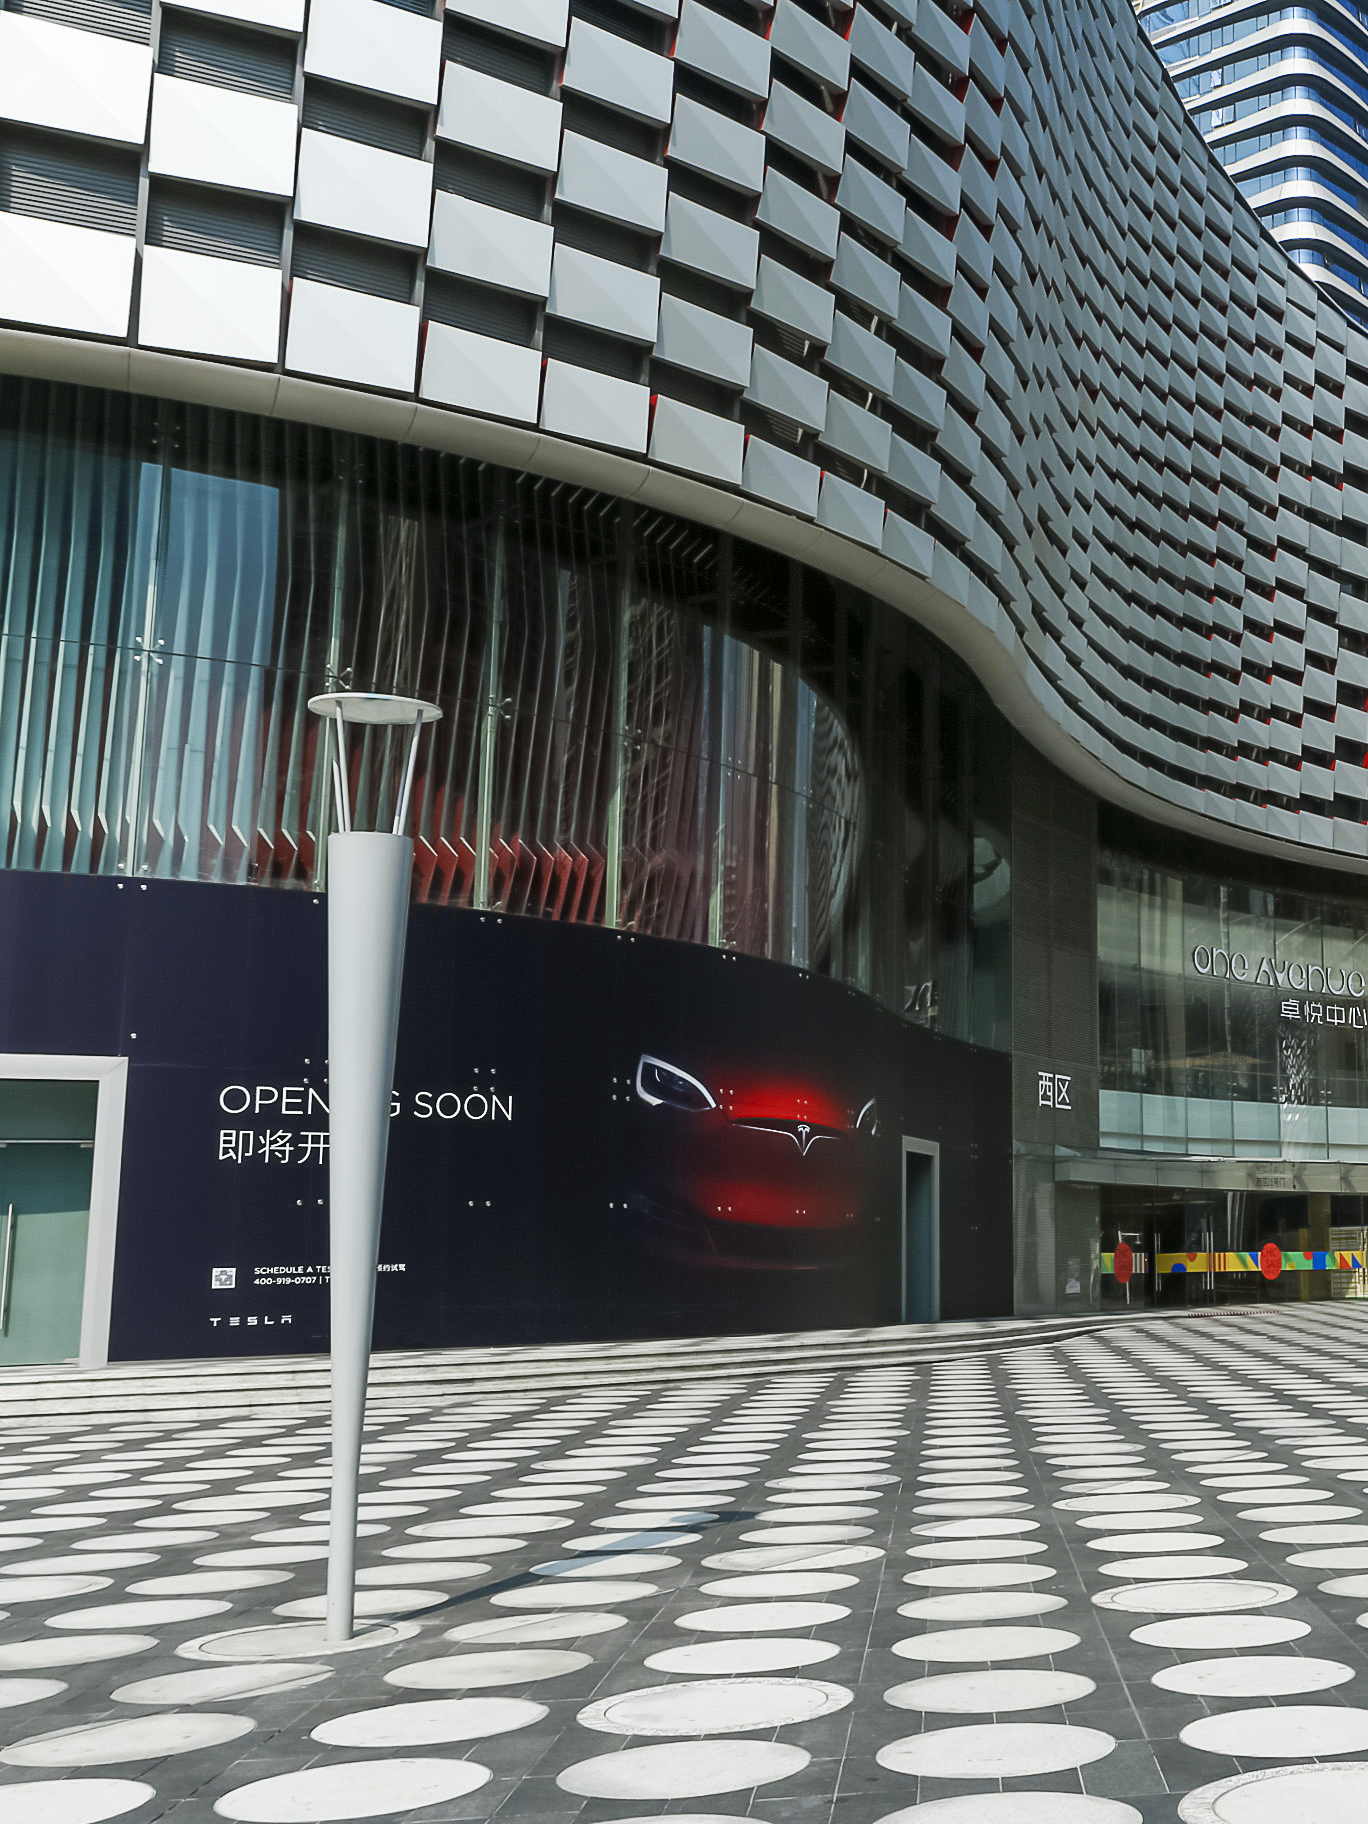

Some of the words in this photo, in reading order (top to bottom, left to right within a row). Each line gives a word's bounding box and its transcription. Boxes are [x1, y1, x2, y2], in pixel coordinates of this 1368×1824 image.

[1280, 998, 1368, 1029] 卓悦中心
[1038, 1071, 1072, 1110] 西区
[413, 1091, 513, 1121] SOON
[219, 1129, 330, 1164] 即将开
[253, 1276, 317, 1285] 400-919-0707
[254, 1266, 304, 1275] SCHEDULE
[209, 1315, 292, 1327] TESLA
